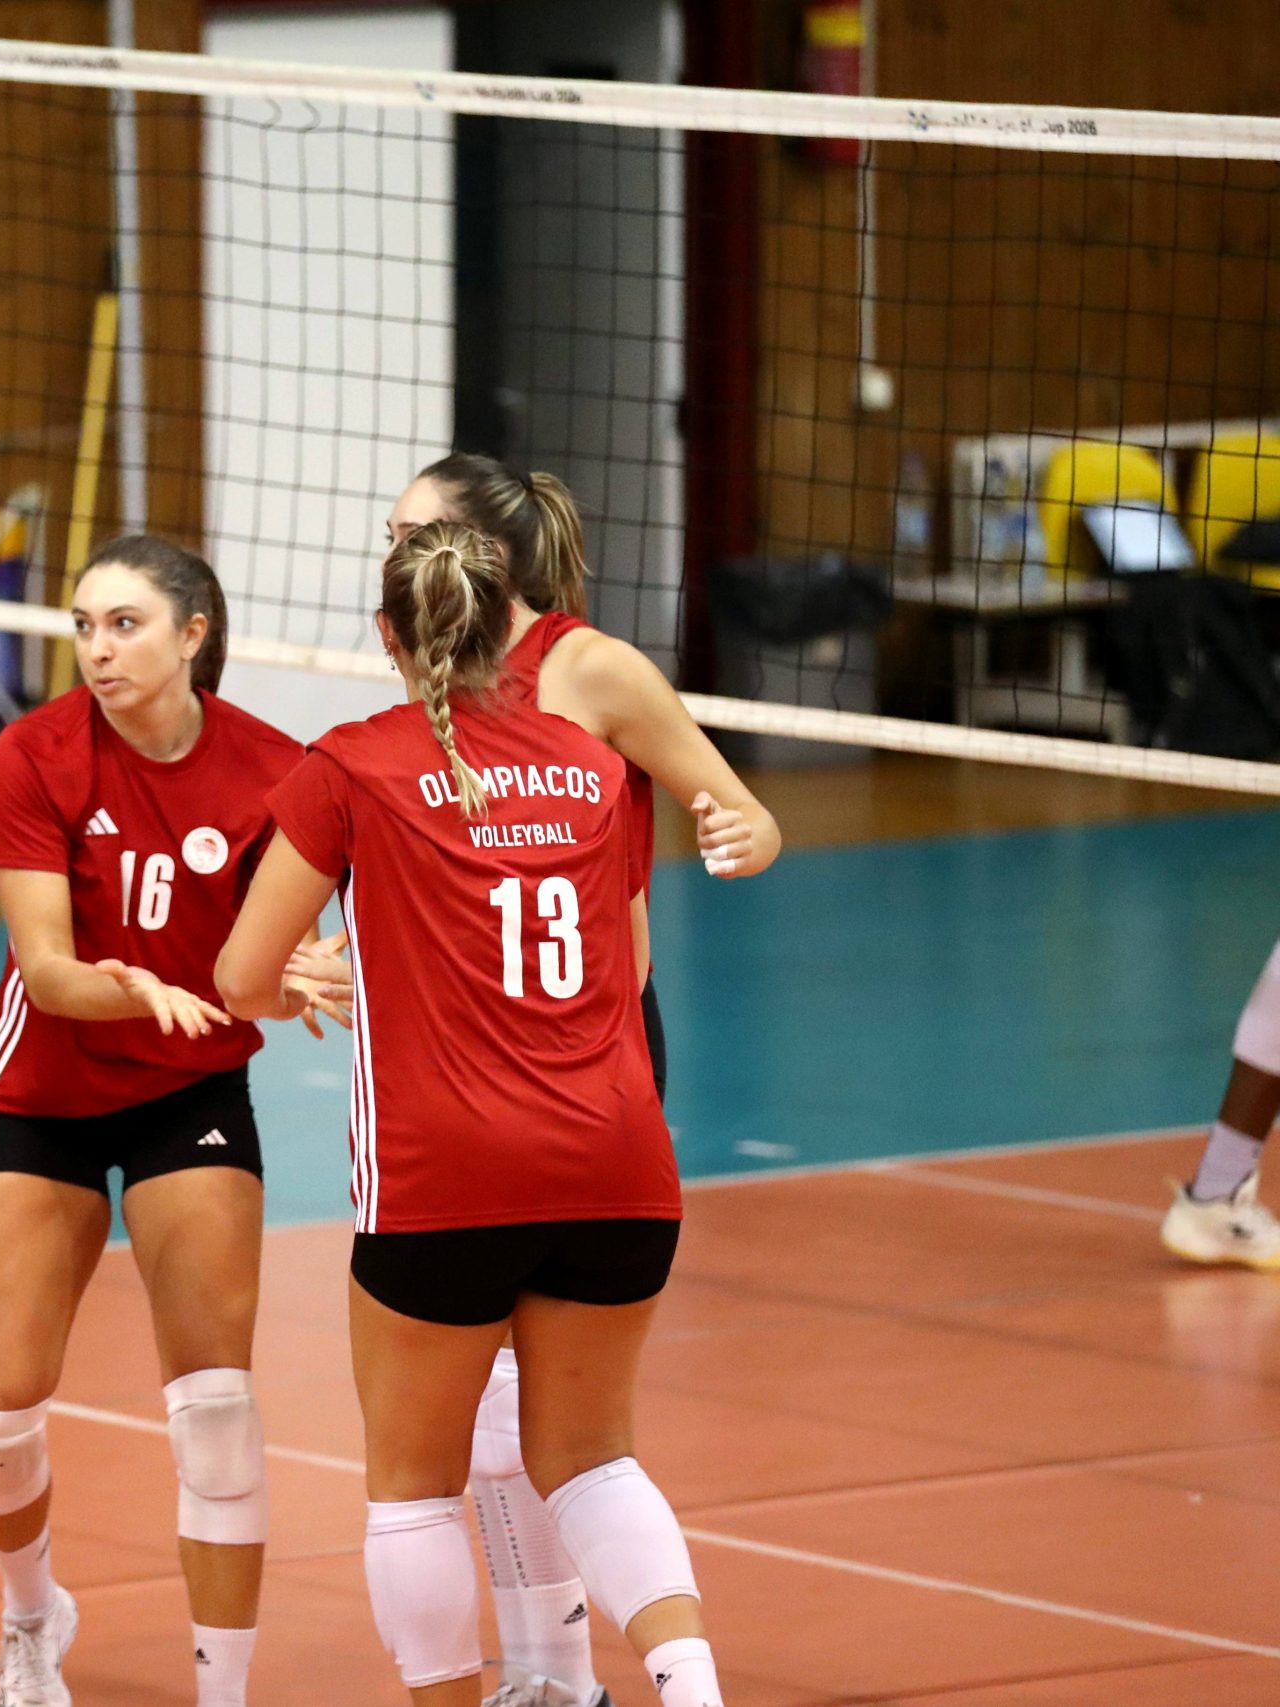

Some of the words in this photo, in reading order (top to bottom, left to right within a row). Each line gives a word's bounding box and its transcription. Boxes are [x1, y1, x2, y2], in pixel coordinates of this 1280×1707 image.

[419, 765, 601, 808] OLMPIACOS
[469, 822, 577, 848] VOLLEYBALL
[121, 850, 175, 931] 16
[489, 876, 584, 999] 13
